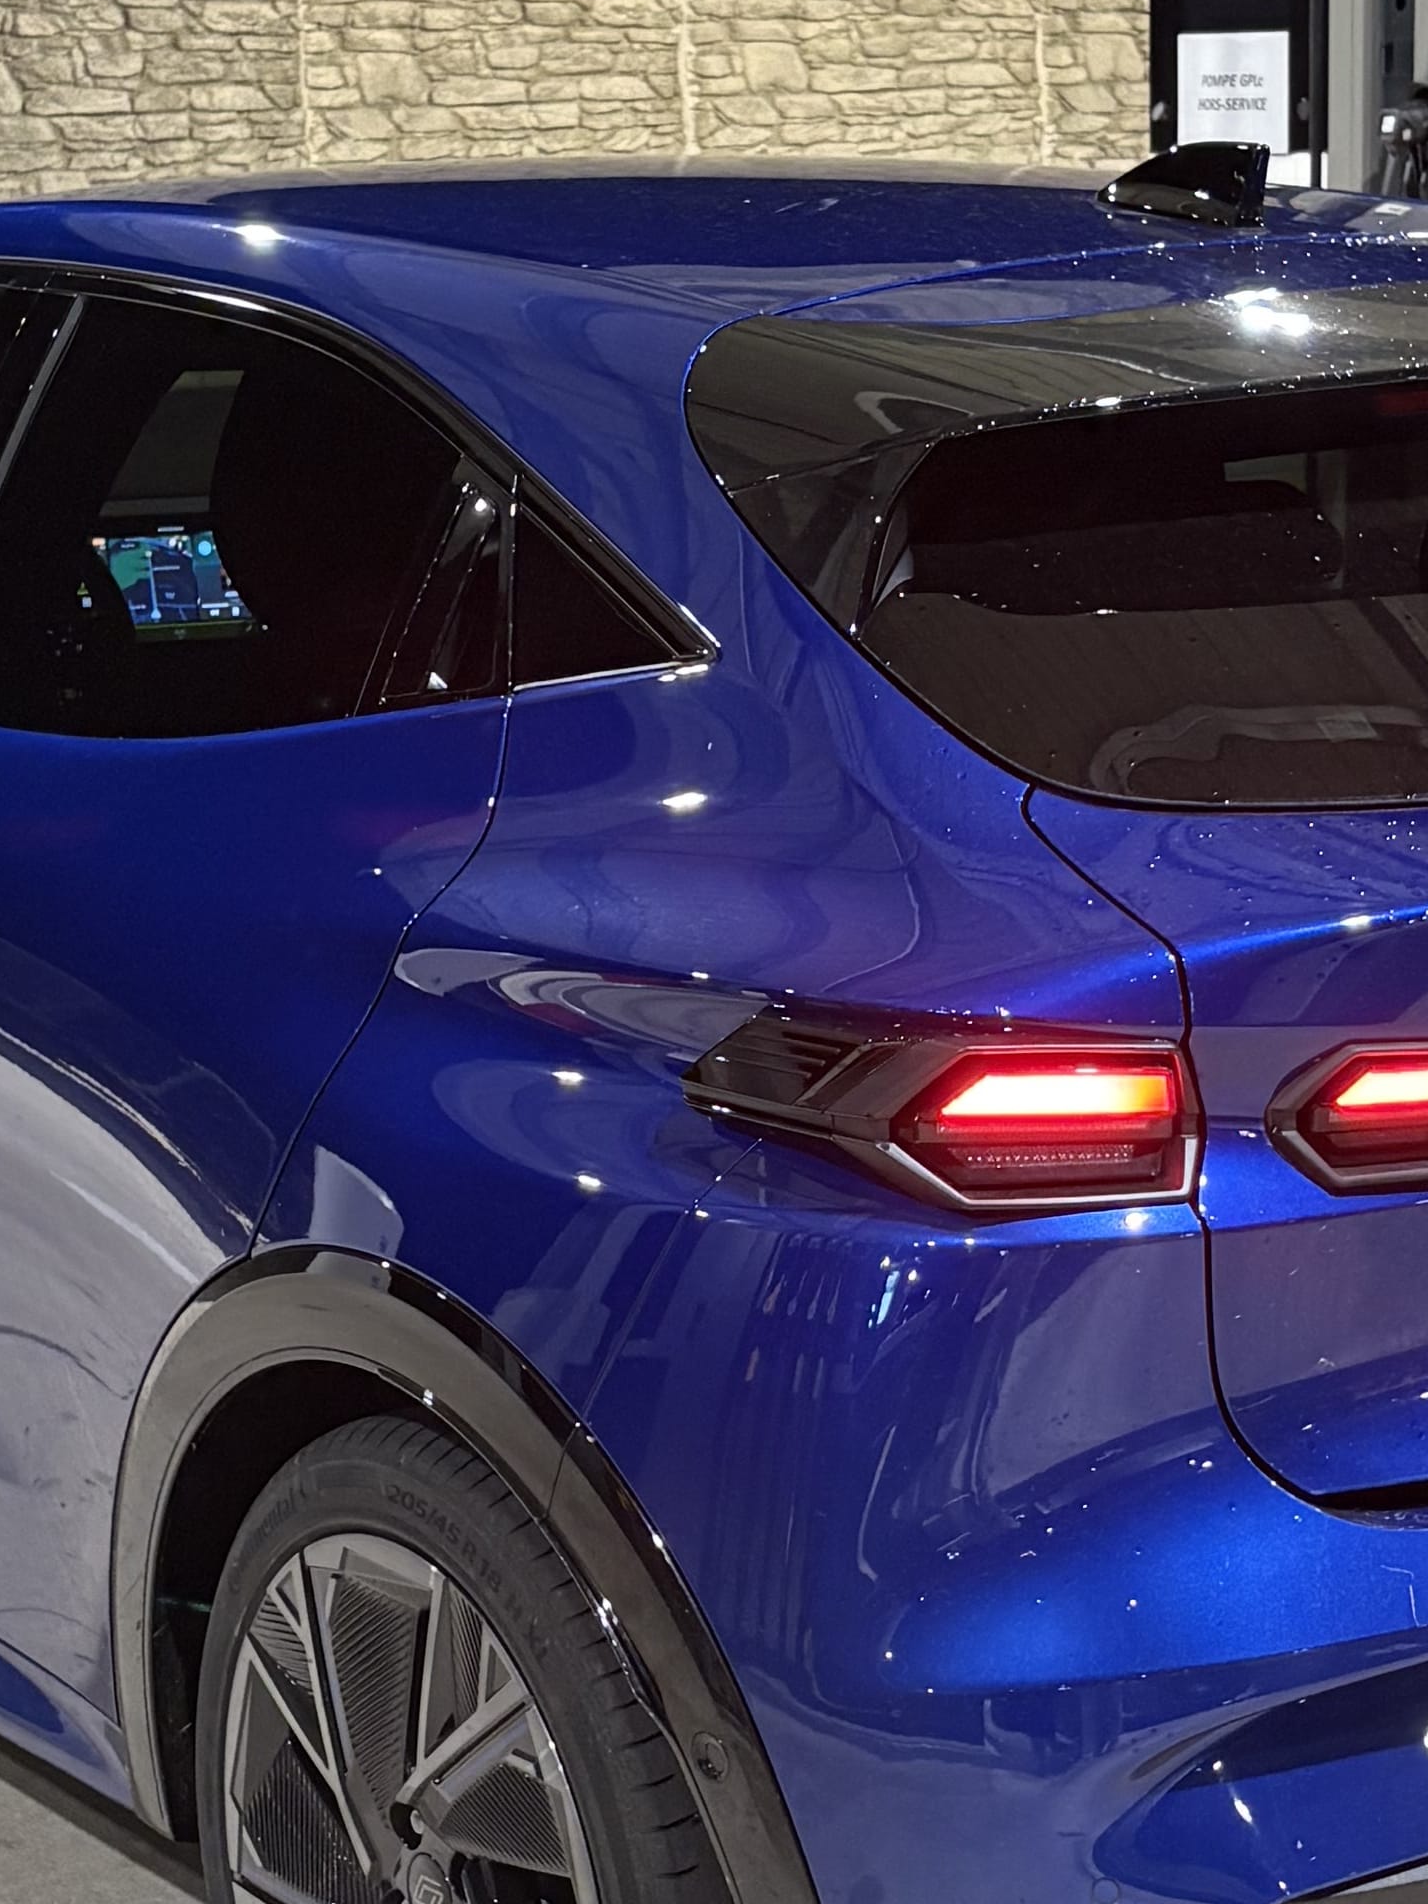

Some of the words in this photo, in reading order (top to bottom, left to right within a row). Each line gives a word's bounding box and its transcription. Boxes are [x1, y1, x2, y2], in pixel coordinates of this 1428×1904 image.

[1201, 73, 1238, 88] POMPE
[1197, 96, 1267, 112] HORS-SERVICE
[385, 1483, 461, 1546] 205/45
